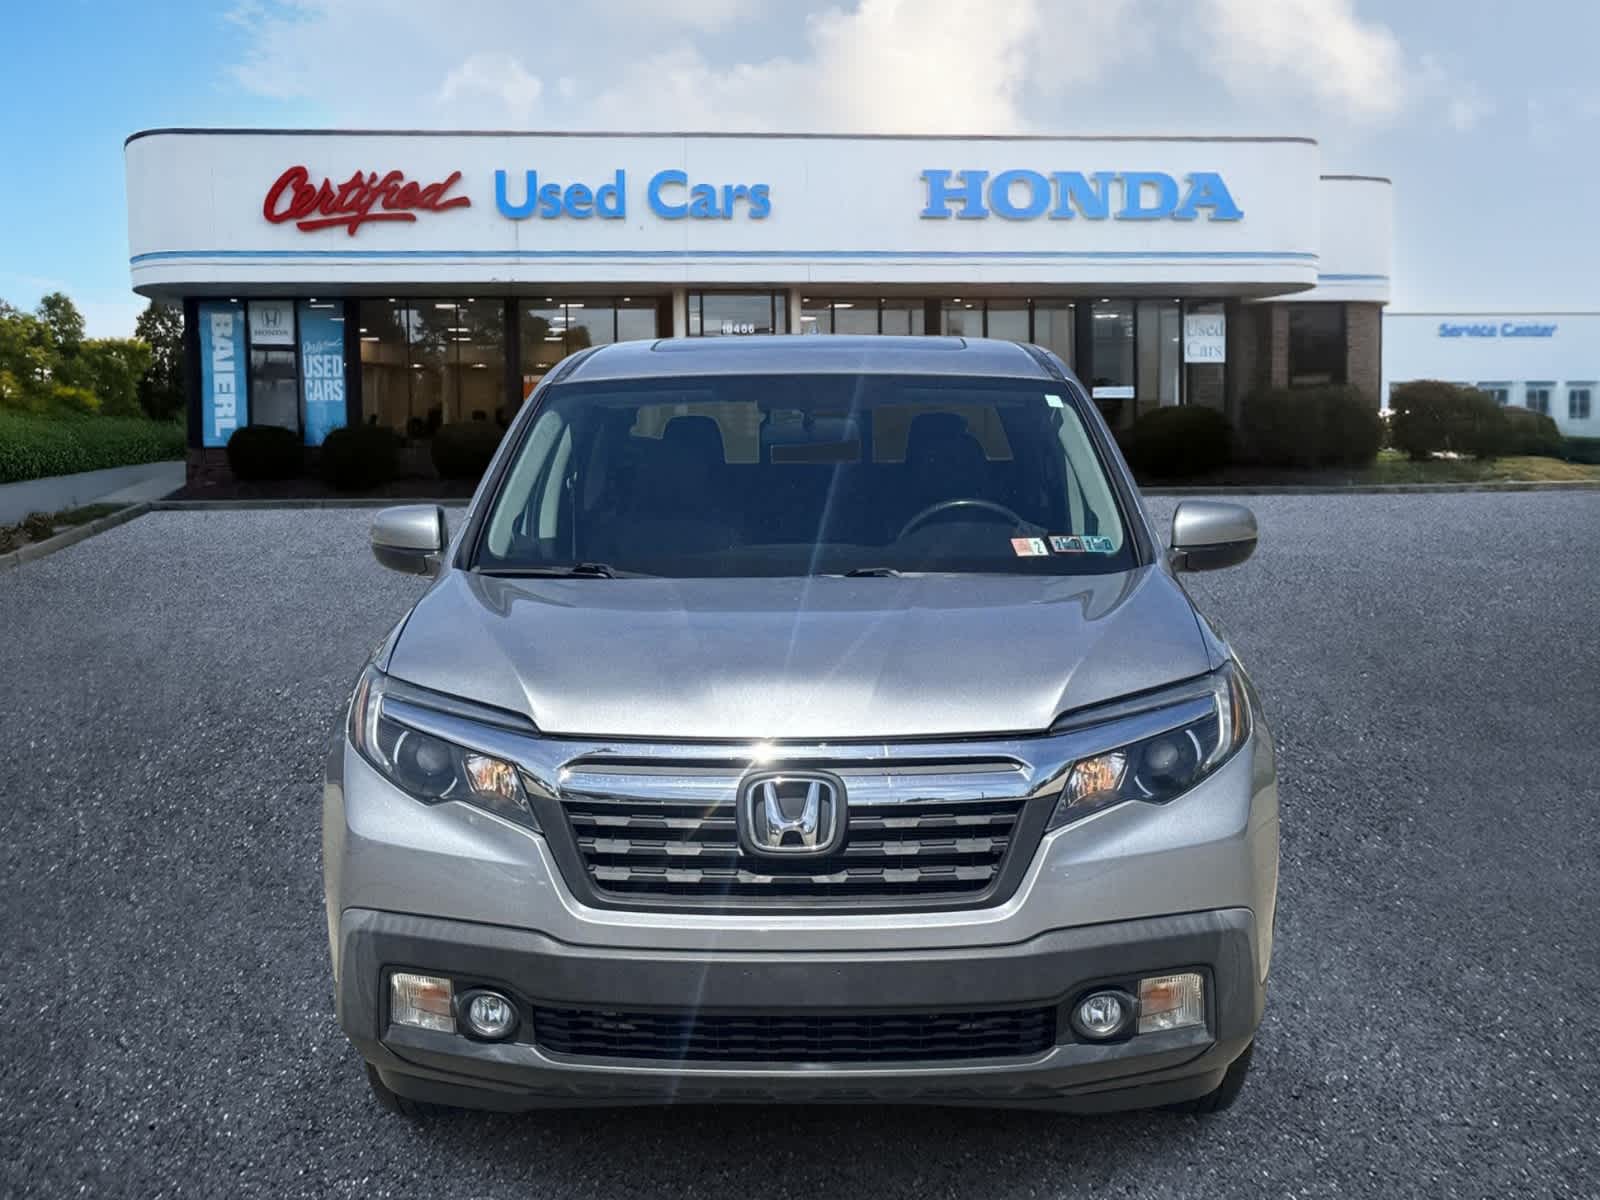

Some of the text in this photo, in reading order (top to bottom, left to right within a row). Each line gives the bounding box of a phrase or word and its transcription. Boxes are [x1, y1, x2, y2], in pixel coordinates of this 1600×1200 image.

[264, 166, 771, 237] Certified Used Cars
[919, 169, 1245, 221] HONDA
[254, 329, 288, 337] HONDA
[1187, 319, 1224, 337] Used
[1438, 322, 1558, 337] Service Center
[1187, 342, 1223, 358] Cars
[210, 313, 237, 437] BAIERL
[304, 354, 343, 378] USED
[305, 379, 344, 402] CARS
